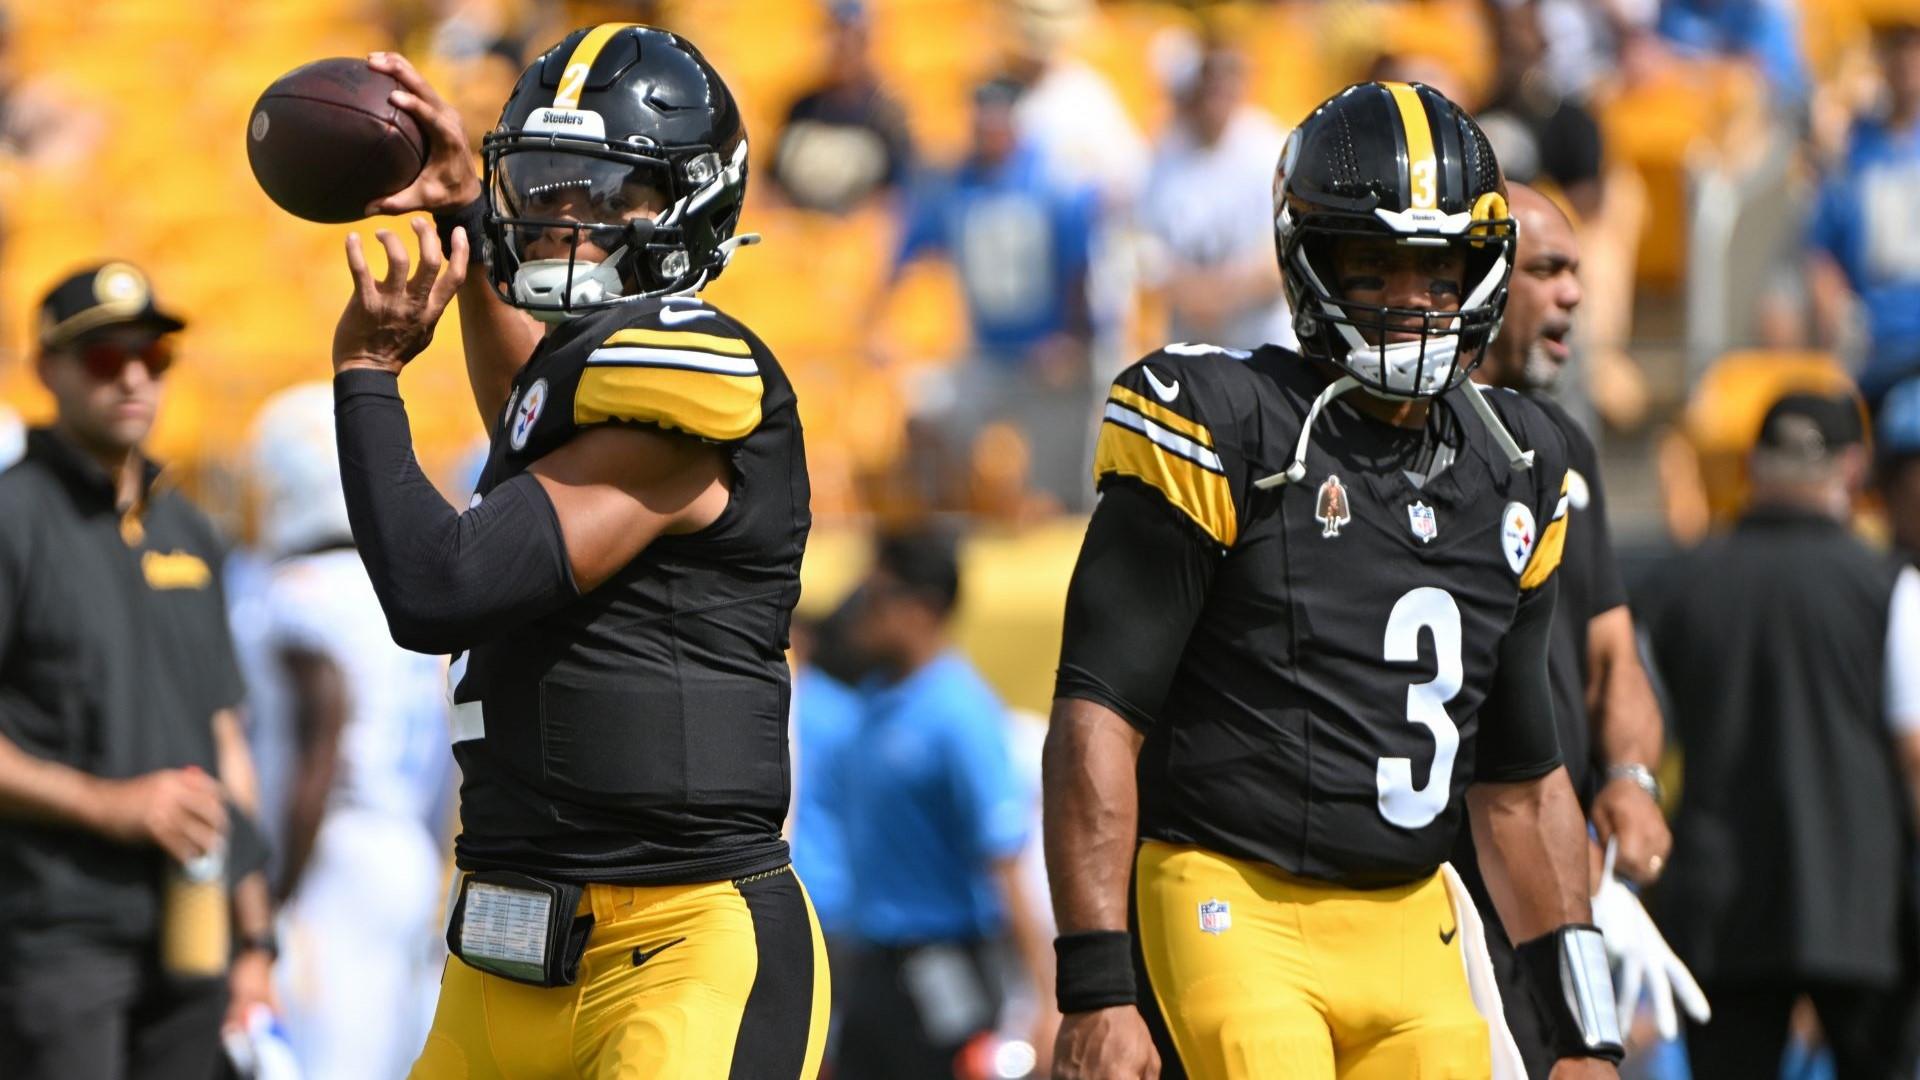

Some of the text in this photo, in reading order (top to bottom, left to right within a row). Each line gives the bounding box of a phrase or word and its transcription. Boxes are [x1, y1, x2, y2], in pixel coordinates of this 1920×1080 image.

[554, 64, 590, 110] 2
[543, 111, 584, 125] Steelers
[1412, 160, 1437, 209] 3
[1376, 586, 1464, 829] 3
